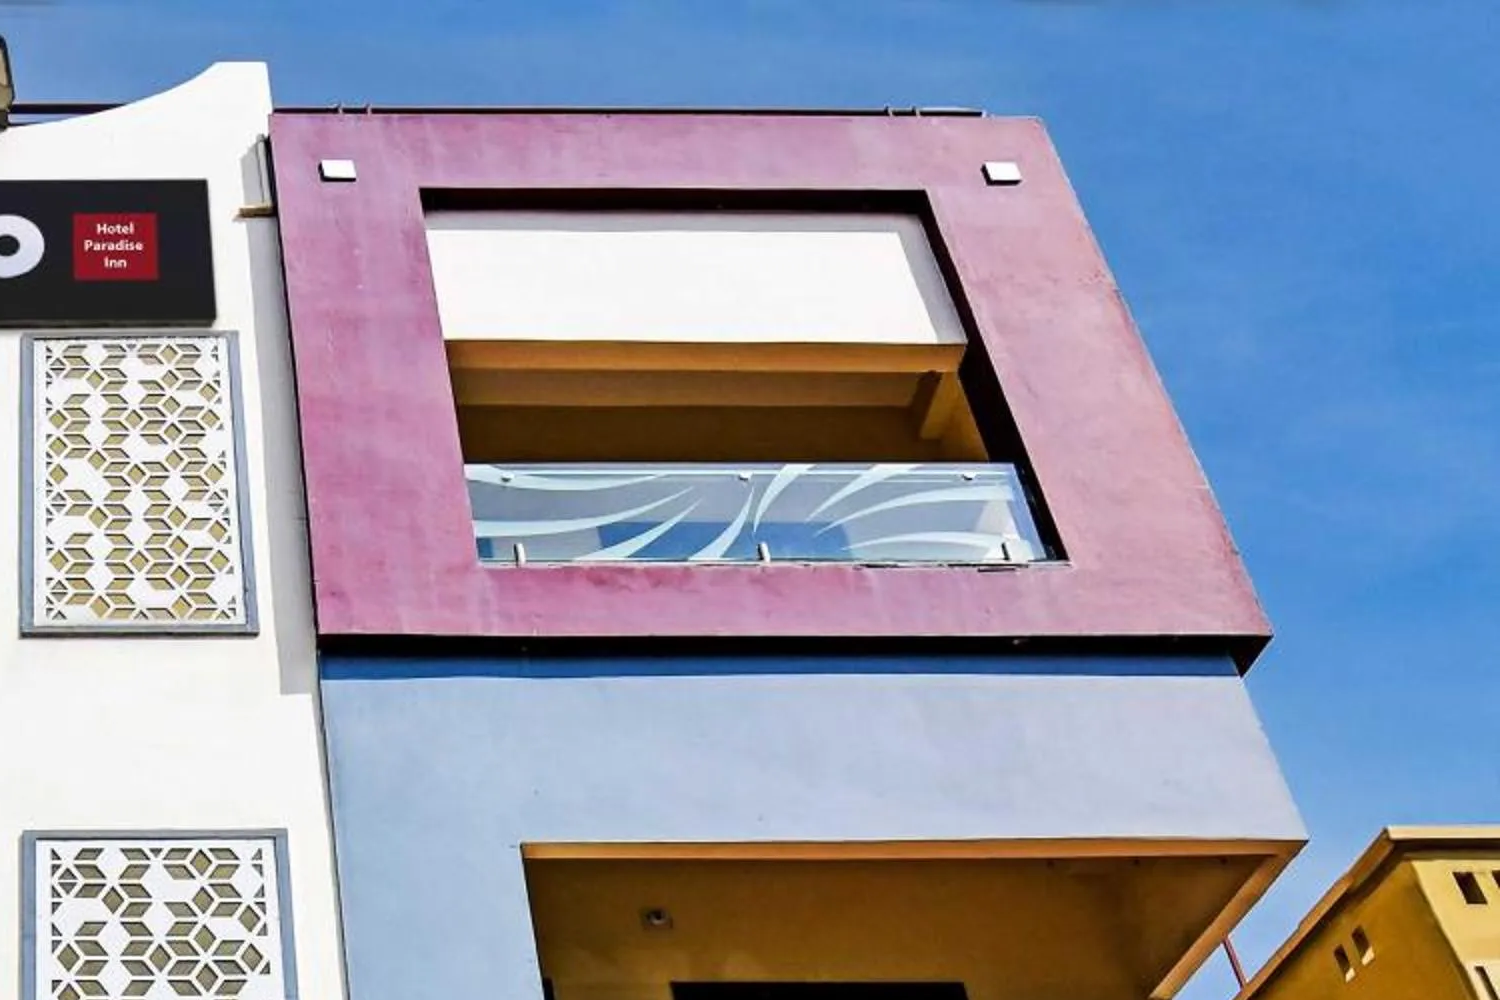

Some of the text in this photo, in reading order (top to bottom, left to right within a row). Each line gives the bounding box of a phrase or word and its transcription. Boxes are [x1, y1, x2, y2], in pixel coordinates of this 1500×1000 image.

[96, 222, 135, 235] Hotel
[84, 239, 143, 252] Paradise
[103, 256, 127, 268] Inn
